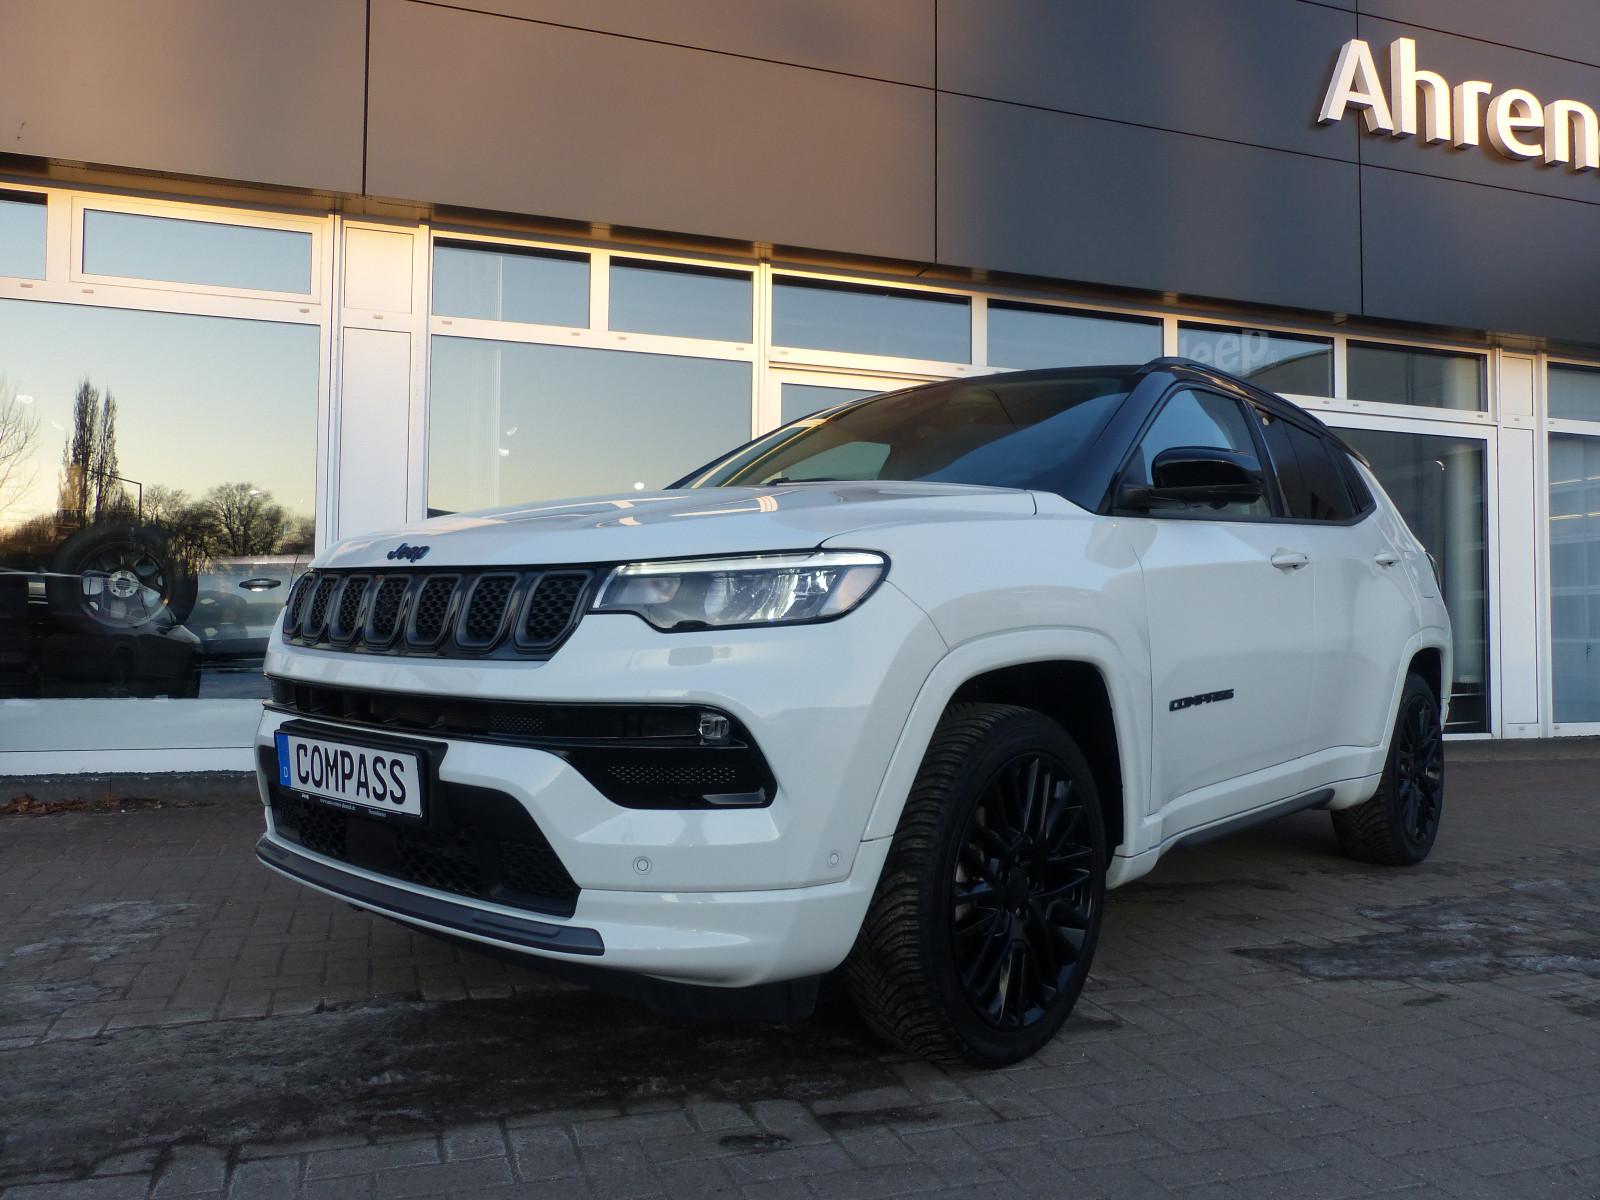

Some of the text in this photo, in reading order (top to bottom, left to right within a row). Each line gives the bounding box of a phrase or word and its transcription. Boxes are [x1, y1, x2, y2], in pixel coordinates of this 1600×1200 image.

[1317, 37, 1600, 171] Ahren
[387, 542, 430, 563] Jeep
[283, 743, 407, 805] D COMPASS
